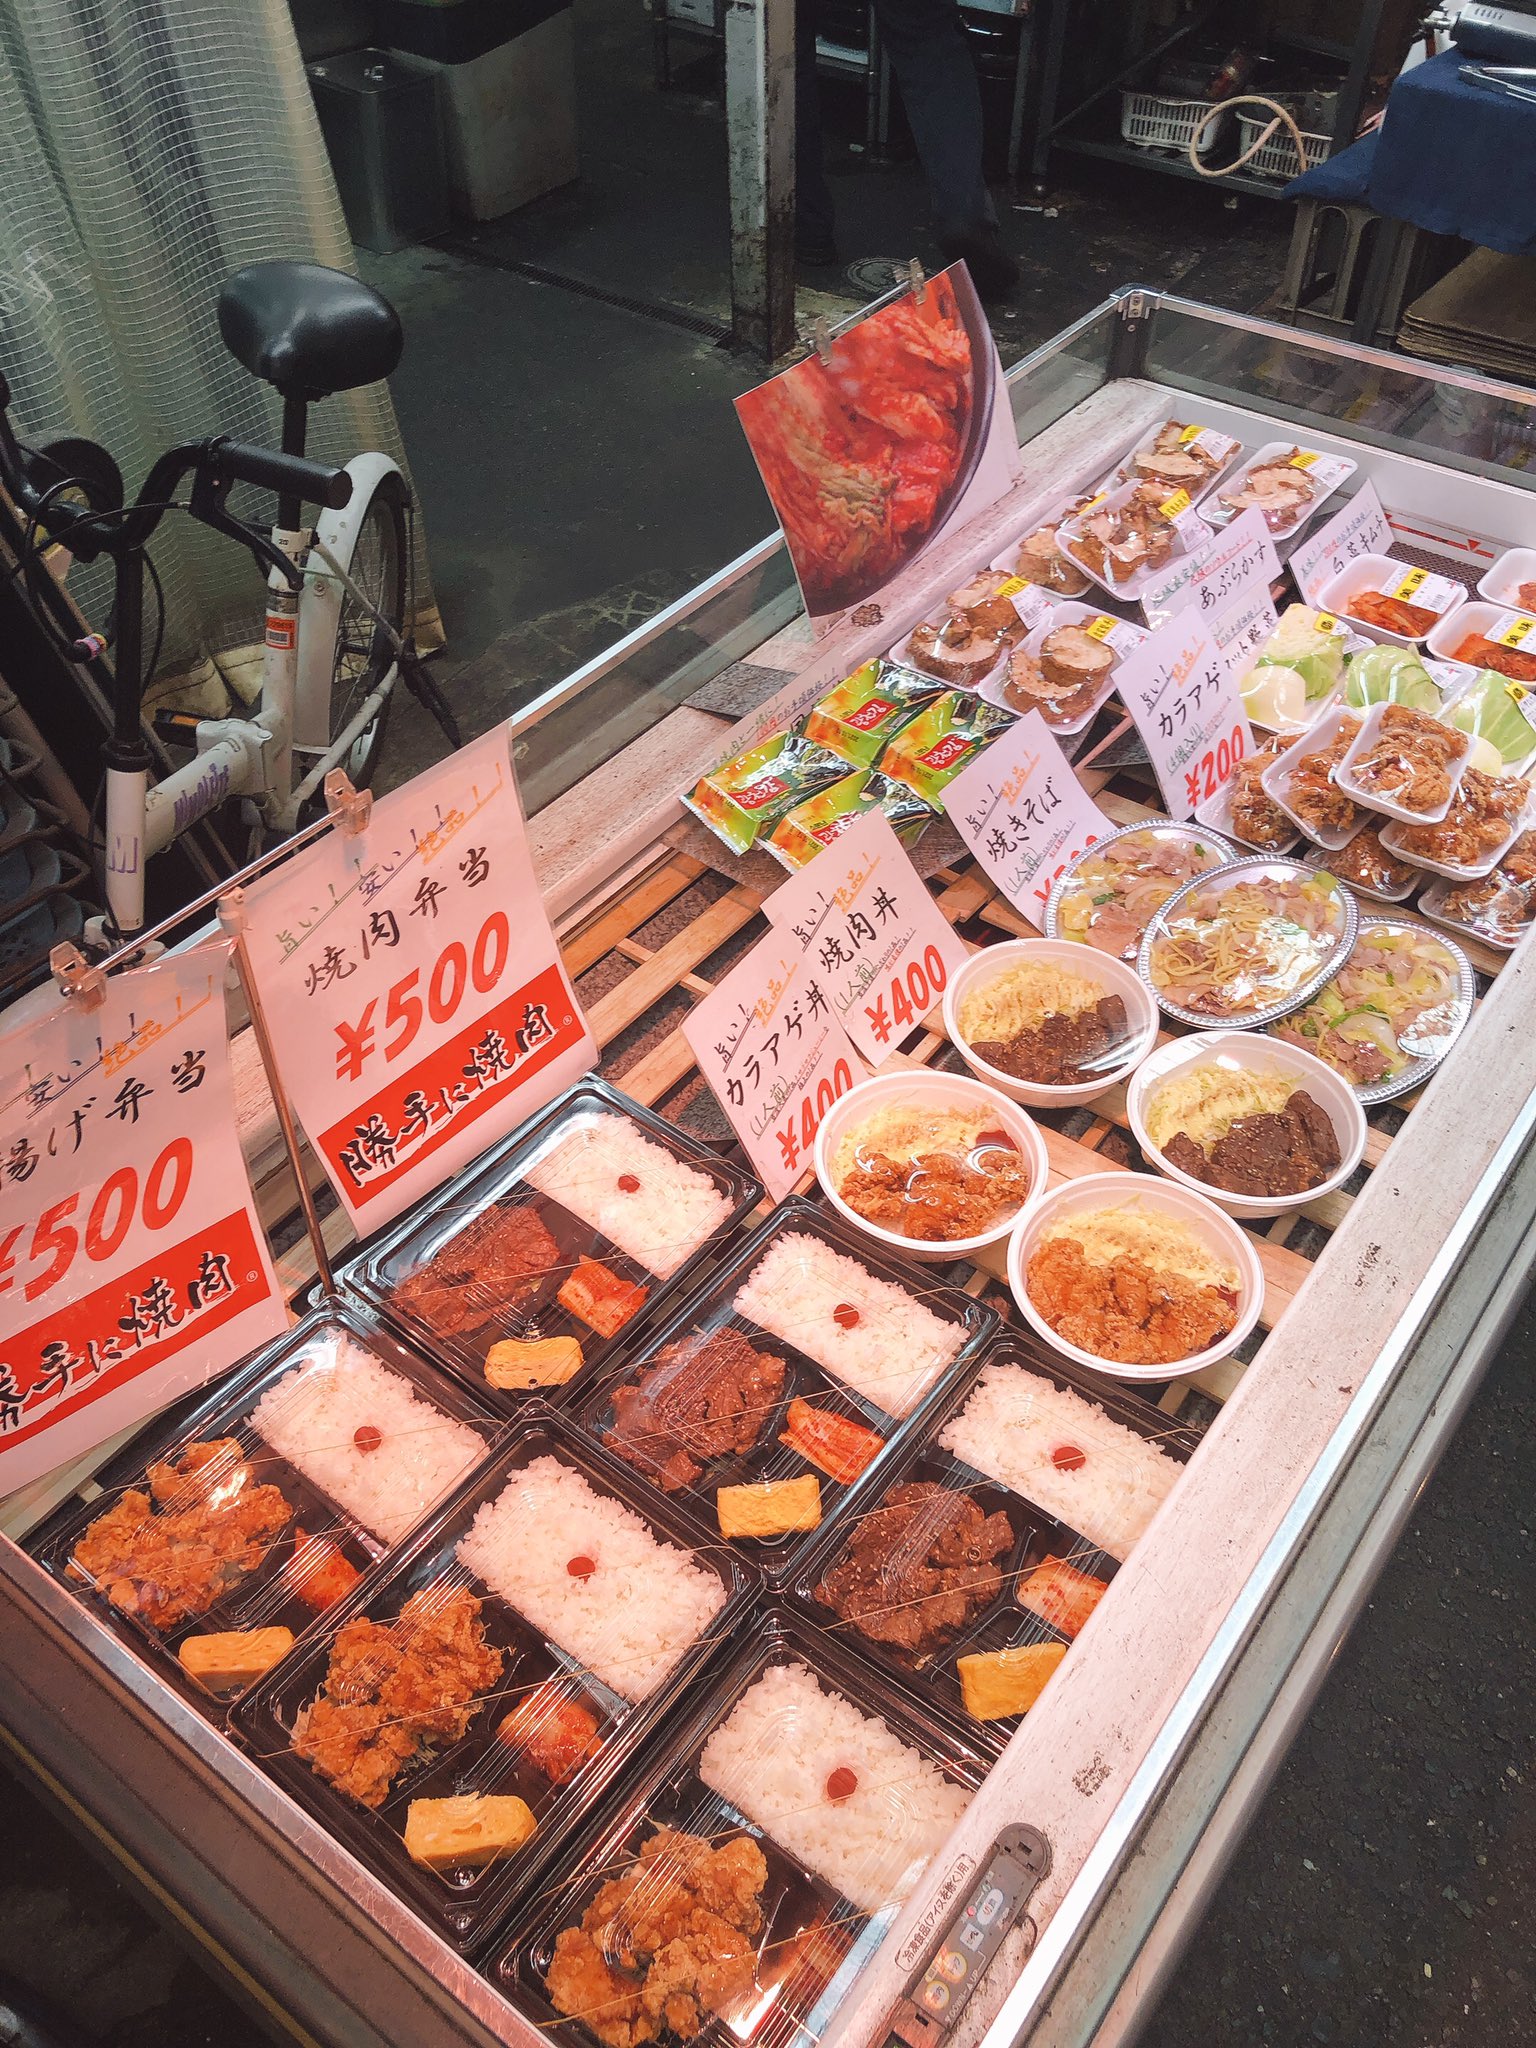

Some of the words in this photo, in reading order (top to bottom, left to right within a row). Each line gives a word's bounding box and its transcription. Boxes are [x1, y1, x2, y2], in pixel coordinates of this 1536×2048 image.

[1200, 541, 1266, 610] あぶらかす
[1158, 661, 1221, 739] カラアゲ
[1184, 725, 1245, 807] ¥200
[965, 784, 1001, 834] 旨い!
[986, 776, 1062, 862] 焼きそば
[303, 846, 490, 997] 焼肉弁当
[792, 891, 830, 945] 旨い!
[819, 886, 899, 974] 焼肉丼
[333, 910, 510, 1082] ¥500
[834, 957, 875, 1012] (1人前)
[864, 944, 947, 1044] ¥400
[714, 1003, 751, 1065] 旨い!
[726, 979, 830, 1107] カラアゲ丼
[339, 1002, 556, 1188] 勝手に焼肉
[750, 1075, 789, 1138] (1人前)
[776, 1057, 853, 1171] ¥400
[902, 1861, 970, 1964] 冷凍食品(アイスを除く)用
[970, 1969, 979, 1983] UP
